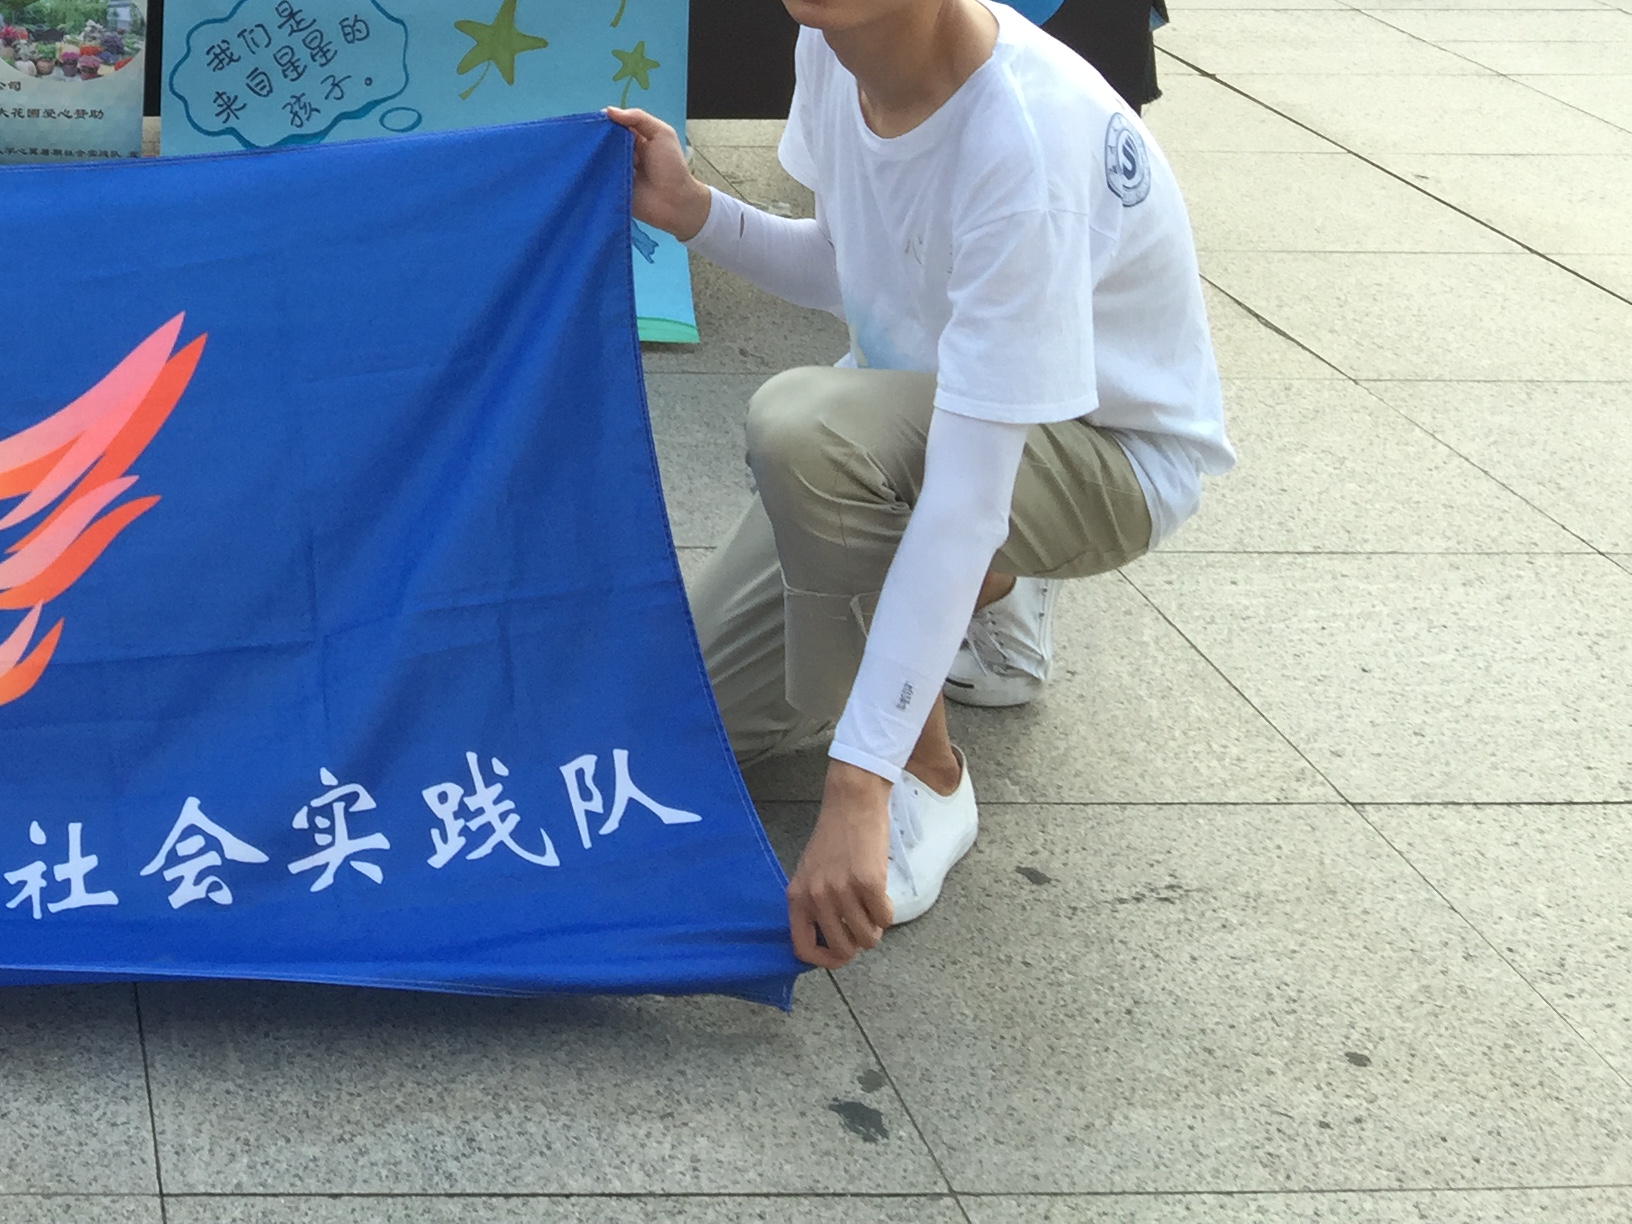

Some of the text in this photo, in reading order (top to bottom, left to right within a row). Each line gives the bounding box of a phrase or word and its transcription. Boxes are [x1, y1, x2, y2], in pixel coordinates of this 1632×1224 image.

[205, 0, 317, 73] 我们是
[212, 14, 370, 125] 来自星星的
